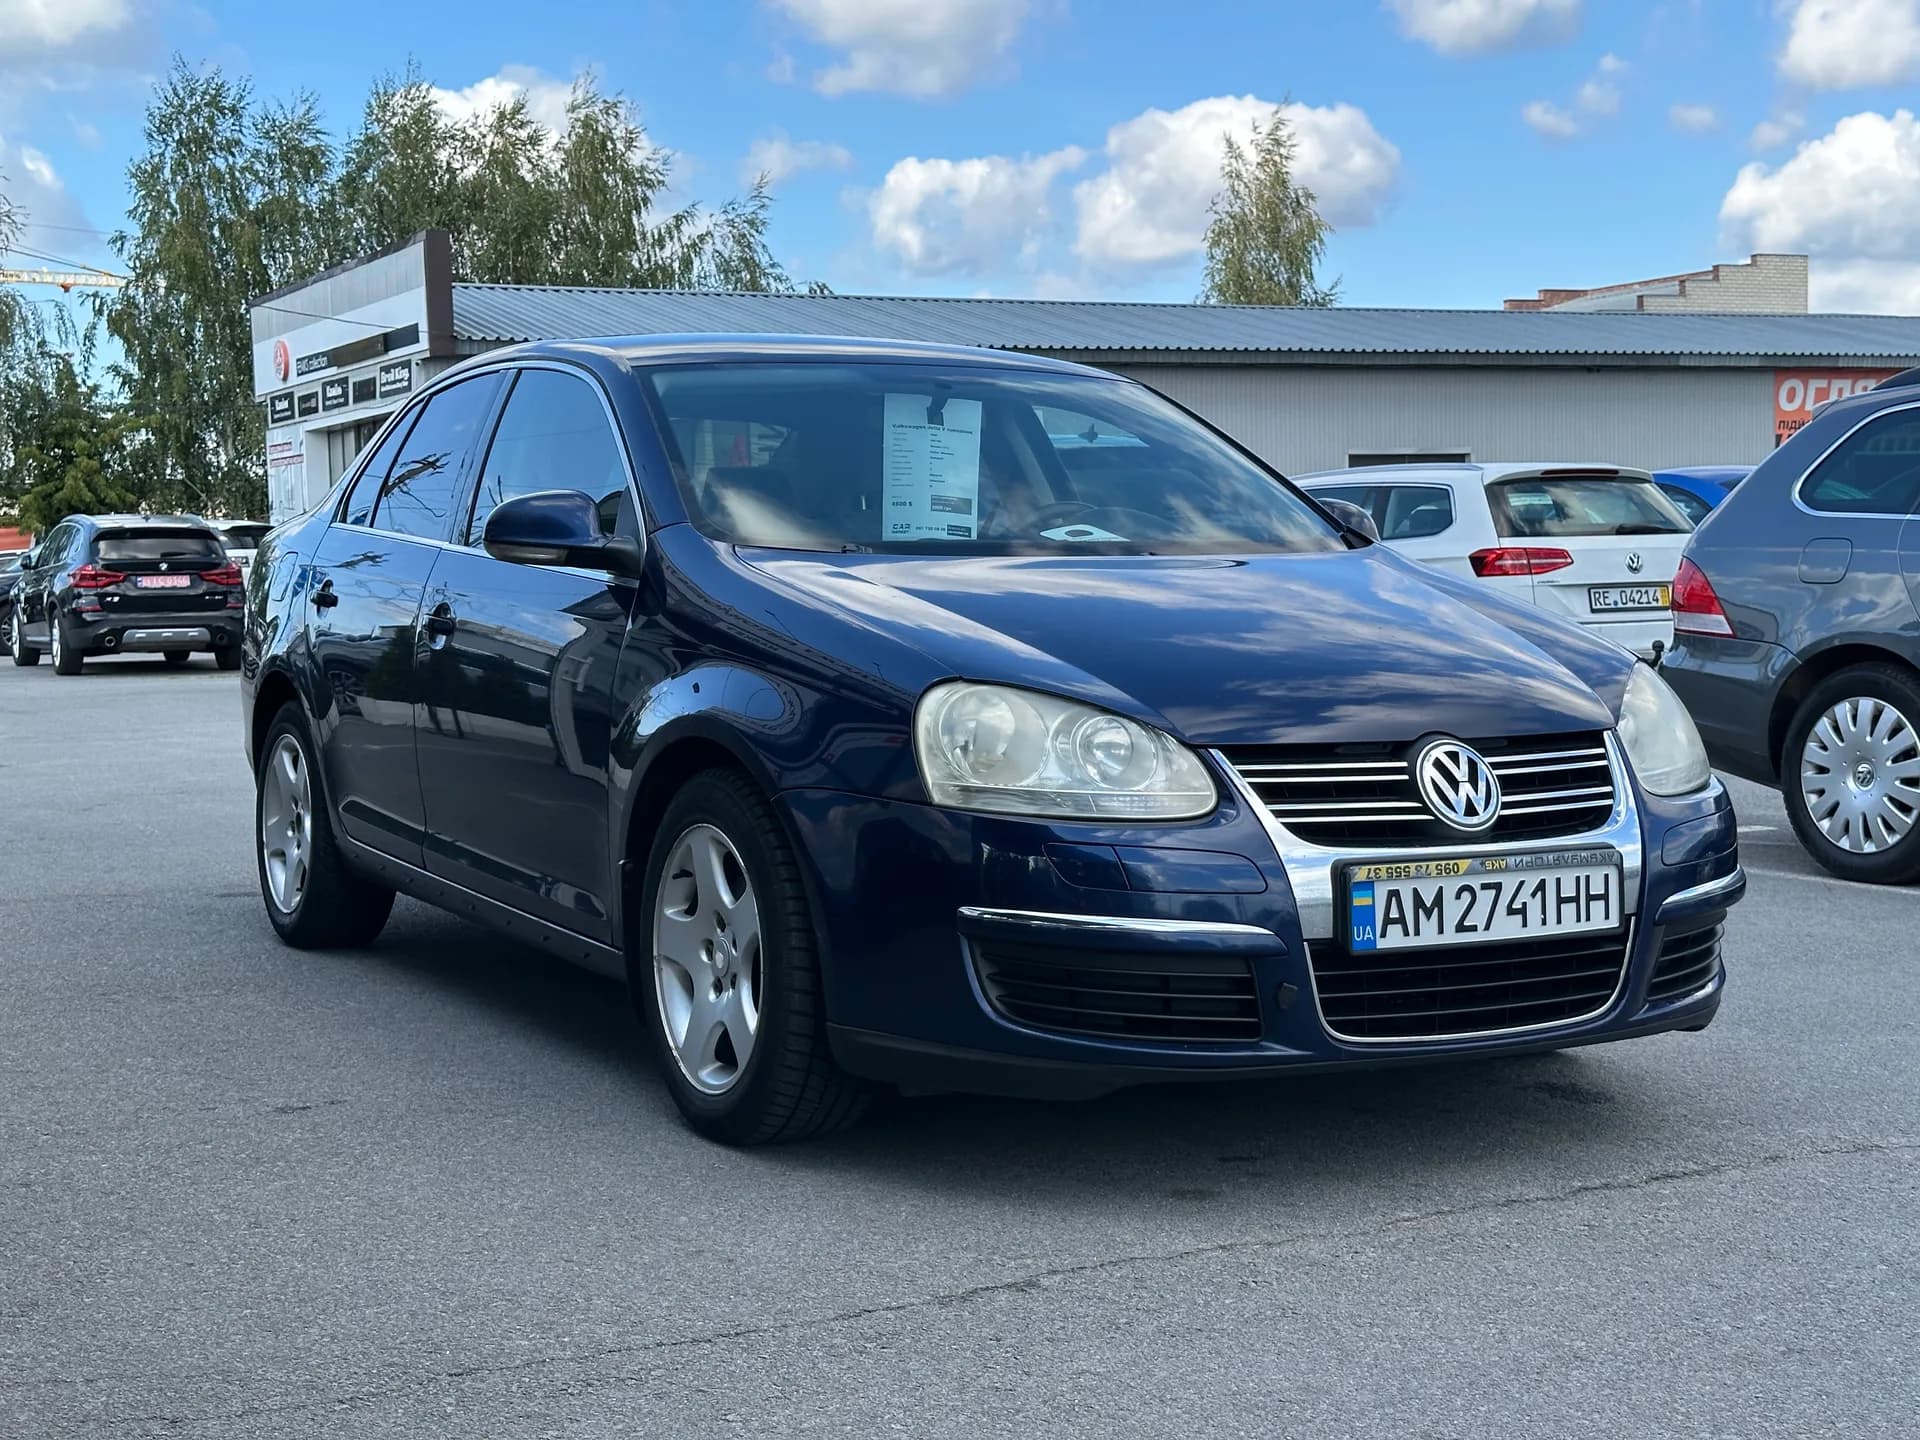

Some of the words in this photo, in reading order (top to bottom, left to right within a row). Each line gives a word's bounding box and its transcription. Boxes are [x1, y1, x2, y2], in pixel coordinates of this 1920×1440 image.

[1593, 590, 1611, 607] RE
[1620, 589, 1660, 606] 04214
[1365, 867, 1382, 880] 37
[1385, 866, 1411, 878] 555
[1434, 862, 1460, 876] 095
[1353, 925, 1374, 942] UA
